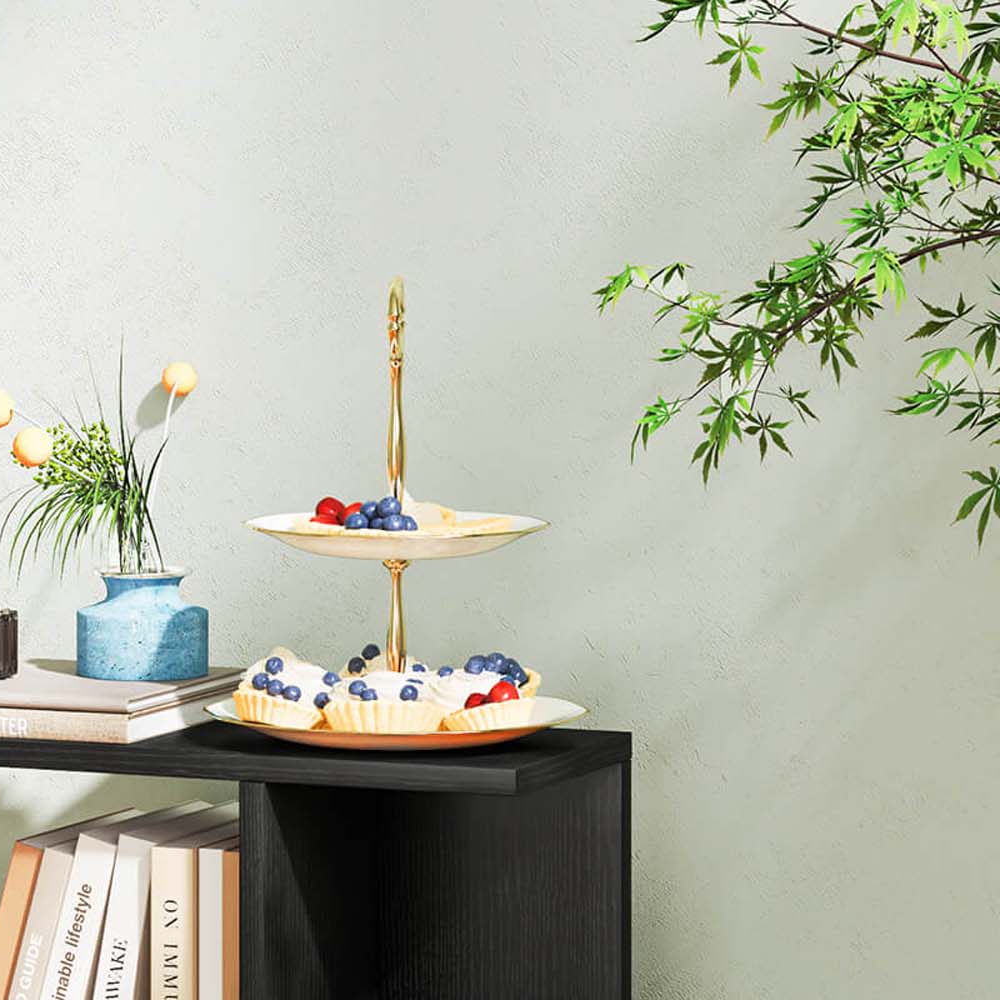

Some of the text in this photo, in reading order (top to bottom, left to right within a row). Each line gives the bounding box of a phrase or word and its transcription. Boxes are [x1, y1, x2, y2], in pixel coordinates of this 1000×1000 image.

[65, 883, 92, 948] lifestyle
[163, 900, 178, 929] ON
[20, 932, 42, 990] GUIDE
